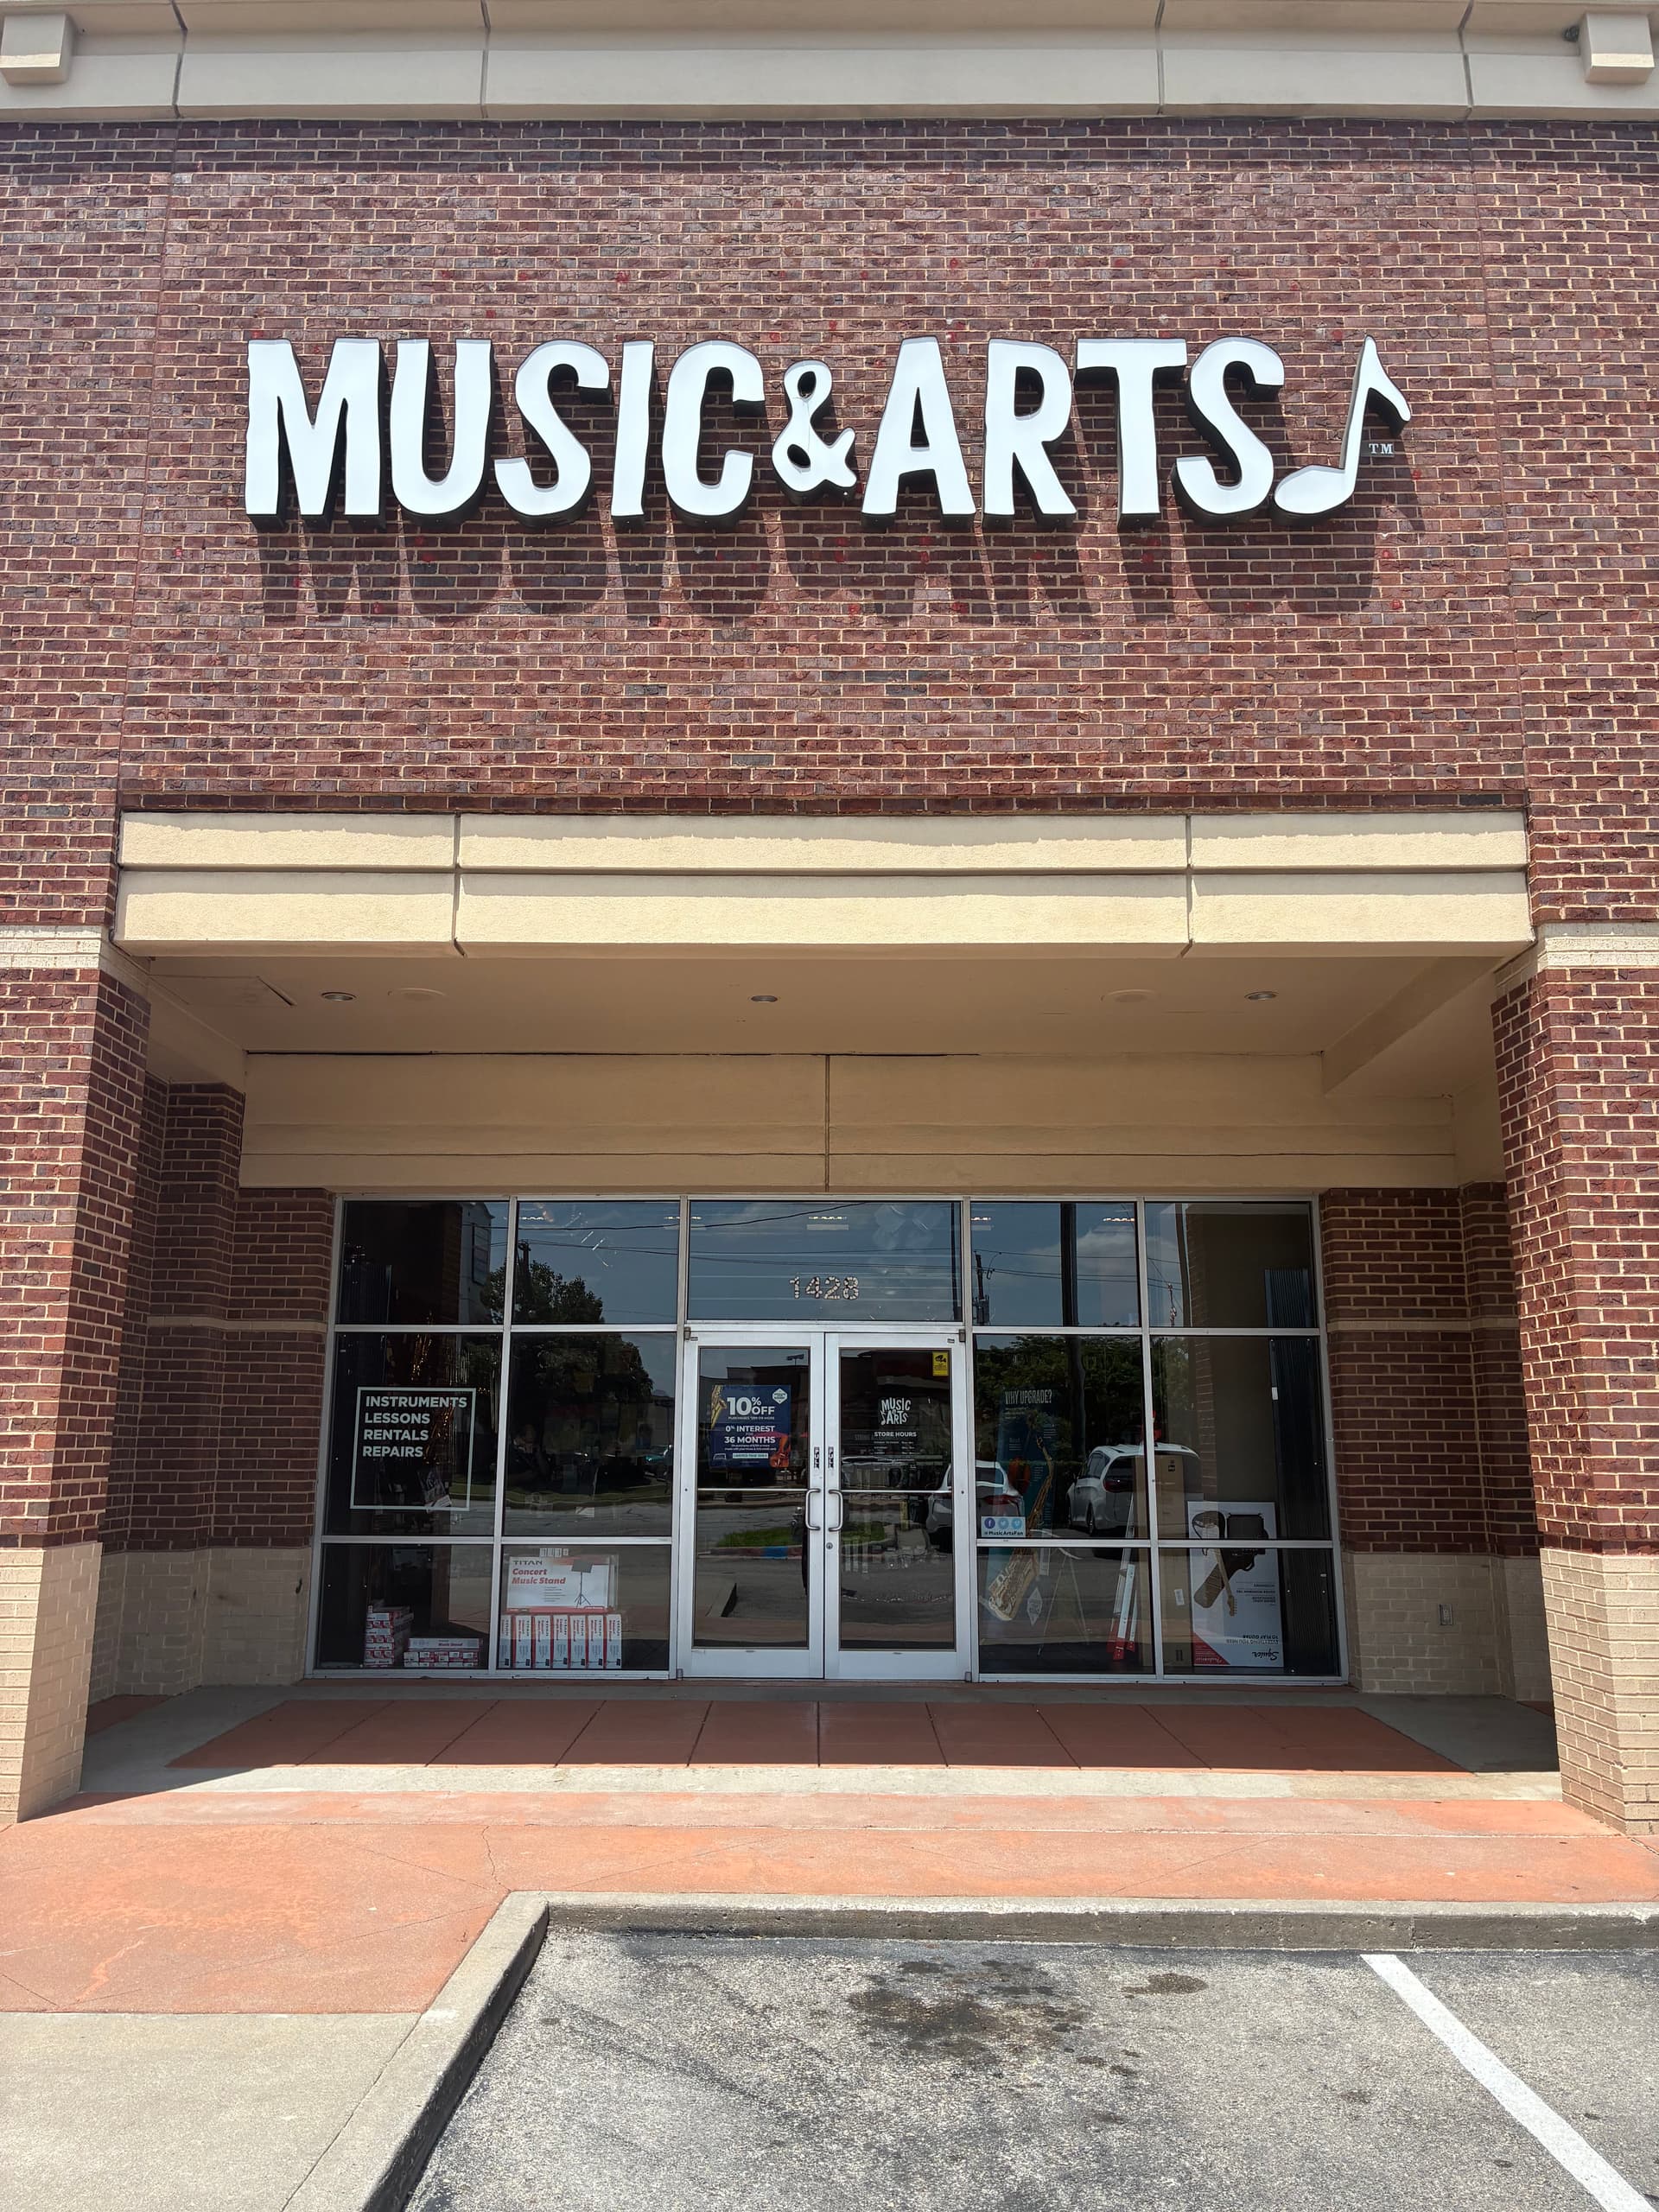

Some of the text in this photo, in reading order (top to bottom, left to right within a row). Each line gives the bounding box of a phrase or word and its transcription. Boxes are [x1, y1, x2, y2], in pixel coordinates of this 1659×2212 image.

[1369, 443, 1394, 454] TM
[789, 1276, 859, 1300] 1428
[365, 1395, 467, 1408] INSTRUMENTS
[1004, 1389, 1052, 1405] WHY UPGRADE?
[752, 1406, 775, 1415] OFF
[880, 1397, 912, 1412] MUSIC
[364, 1412, 430, 1424] LESSONS
[886, 1410, 909, 1425] ARTS
[363, 1428, 429, 1441] RENTALS
[362, 1446, 423, 1458] REPAIRS
